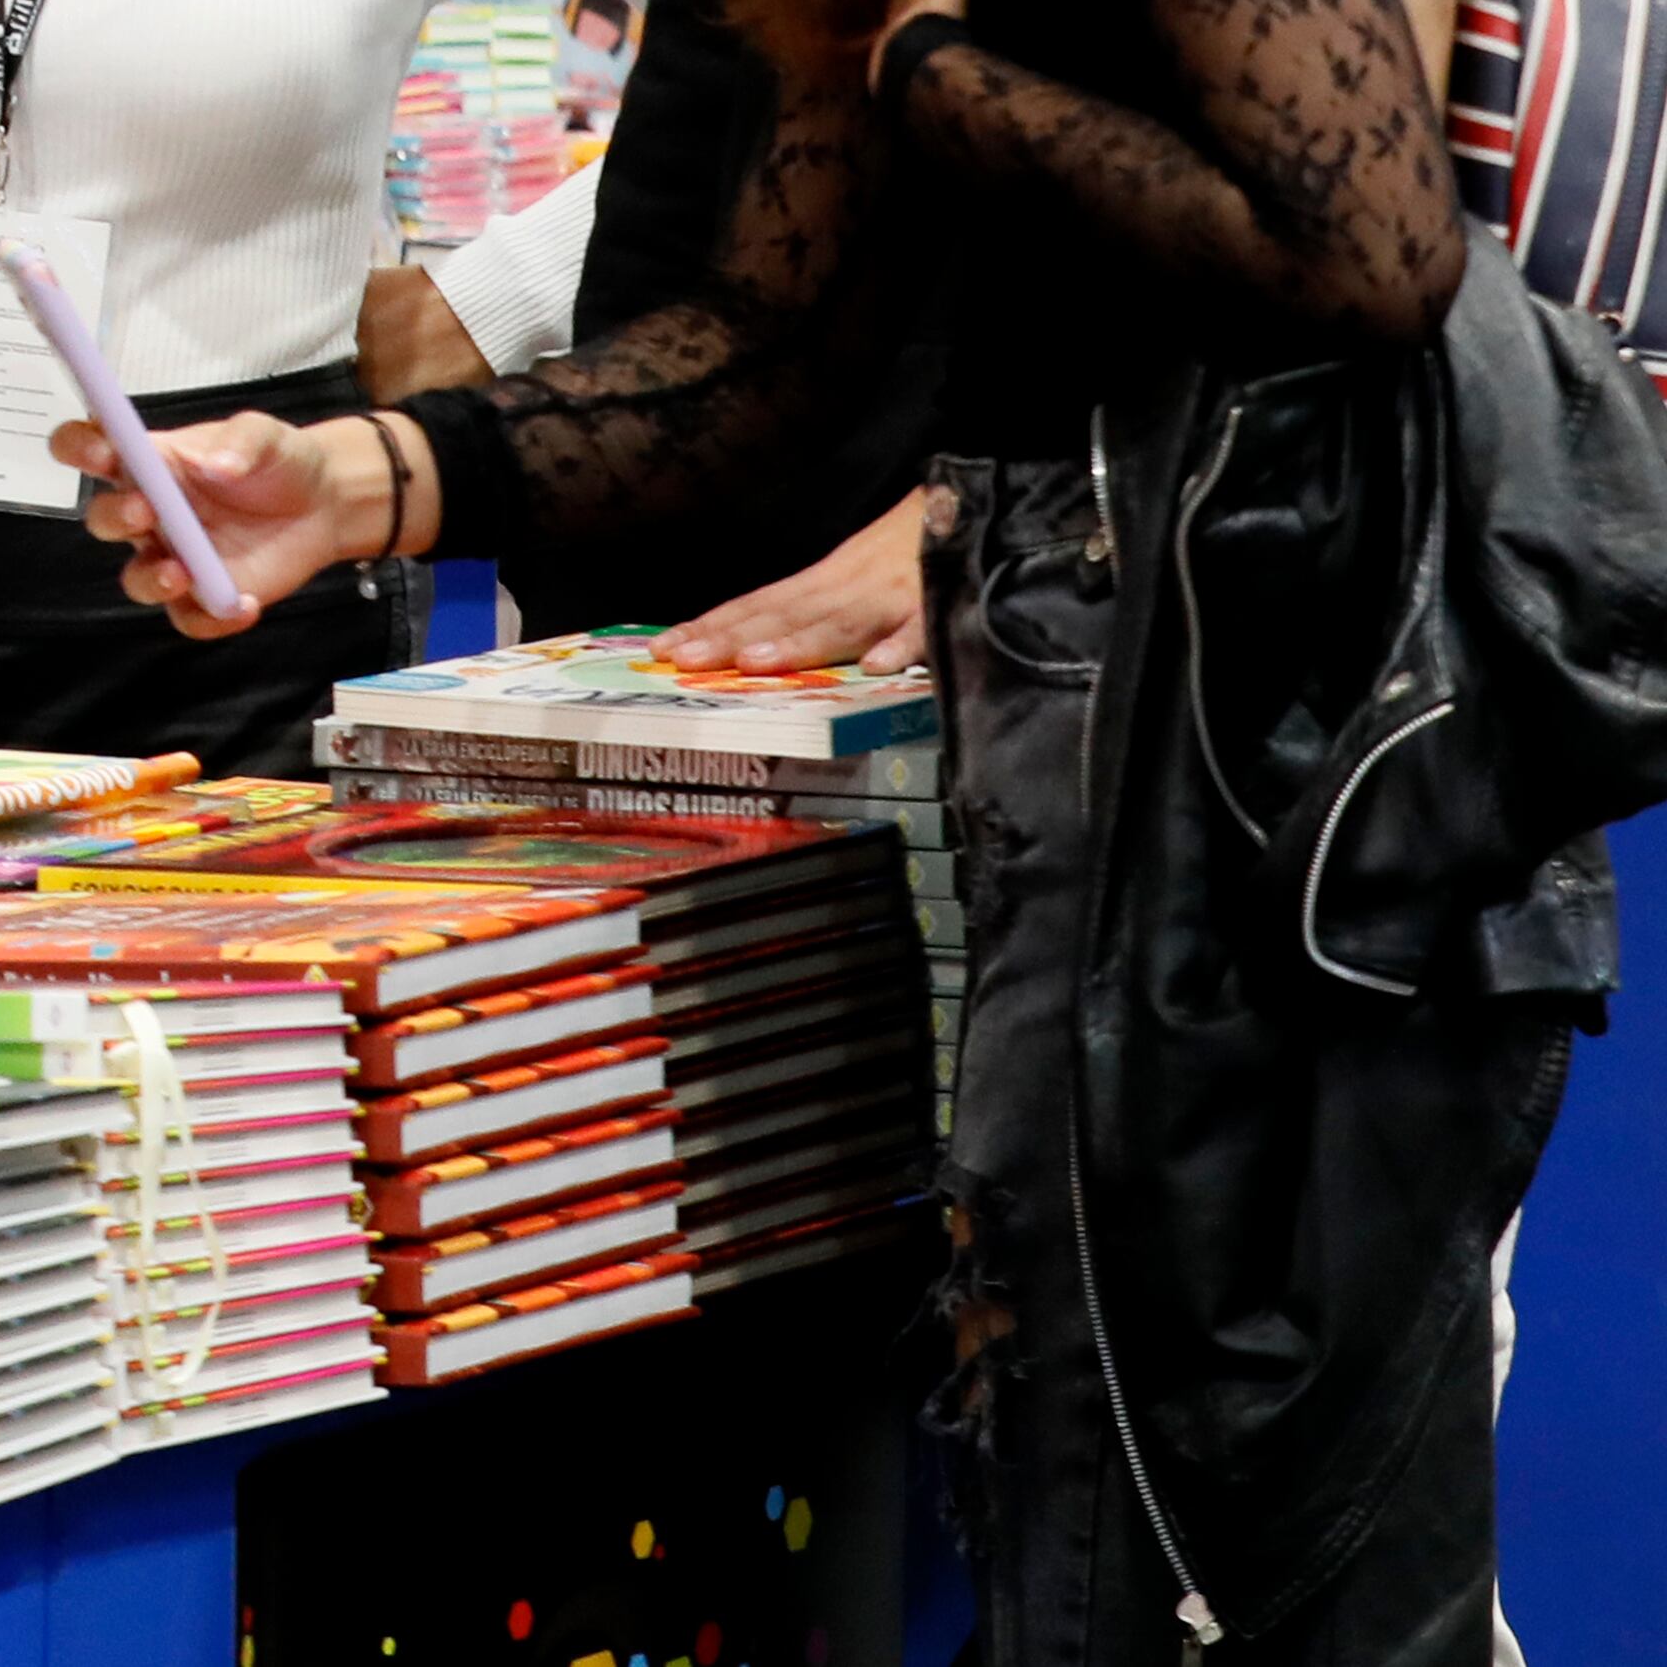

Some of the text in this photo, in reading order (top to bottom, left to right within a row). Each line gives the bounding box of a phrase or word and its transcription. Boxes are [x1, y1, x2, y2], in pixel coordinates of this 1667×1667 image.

[402, 739, 569, 765] LA GRAN ENCICLOPEDIA DE
[574, 741, 769, 789] DINOSAURIOS
